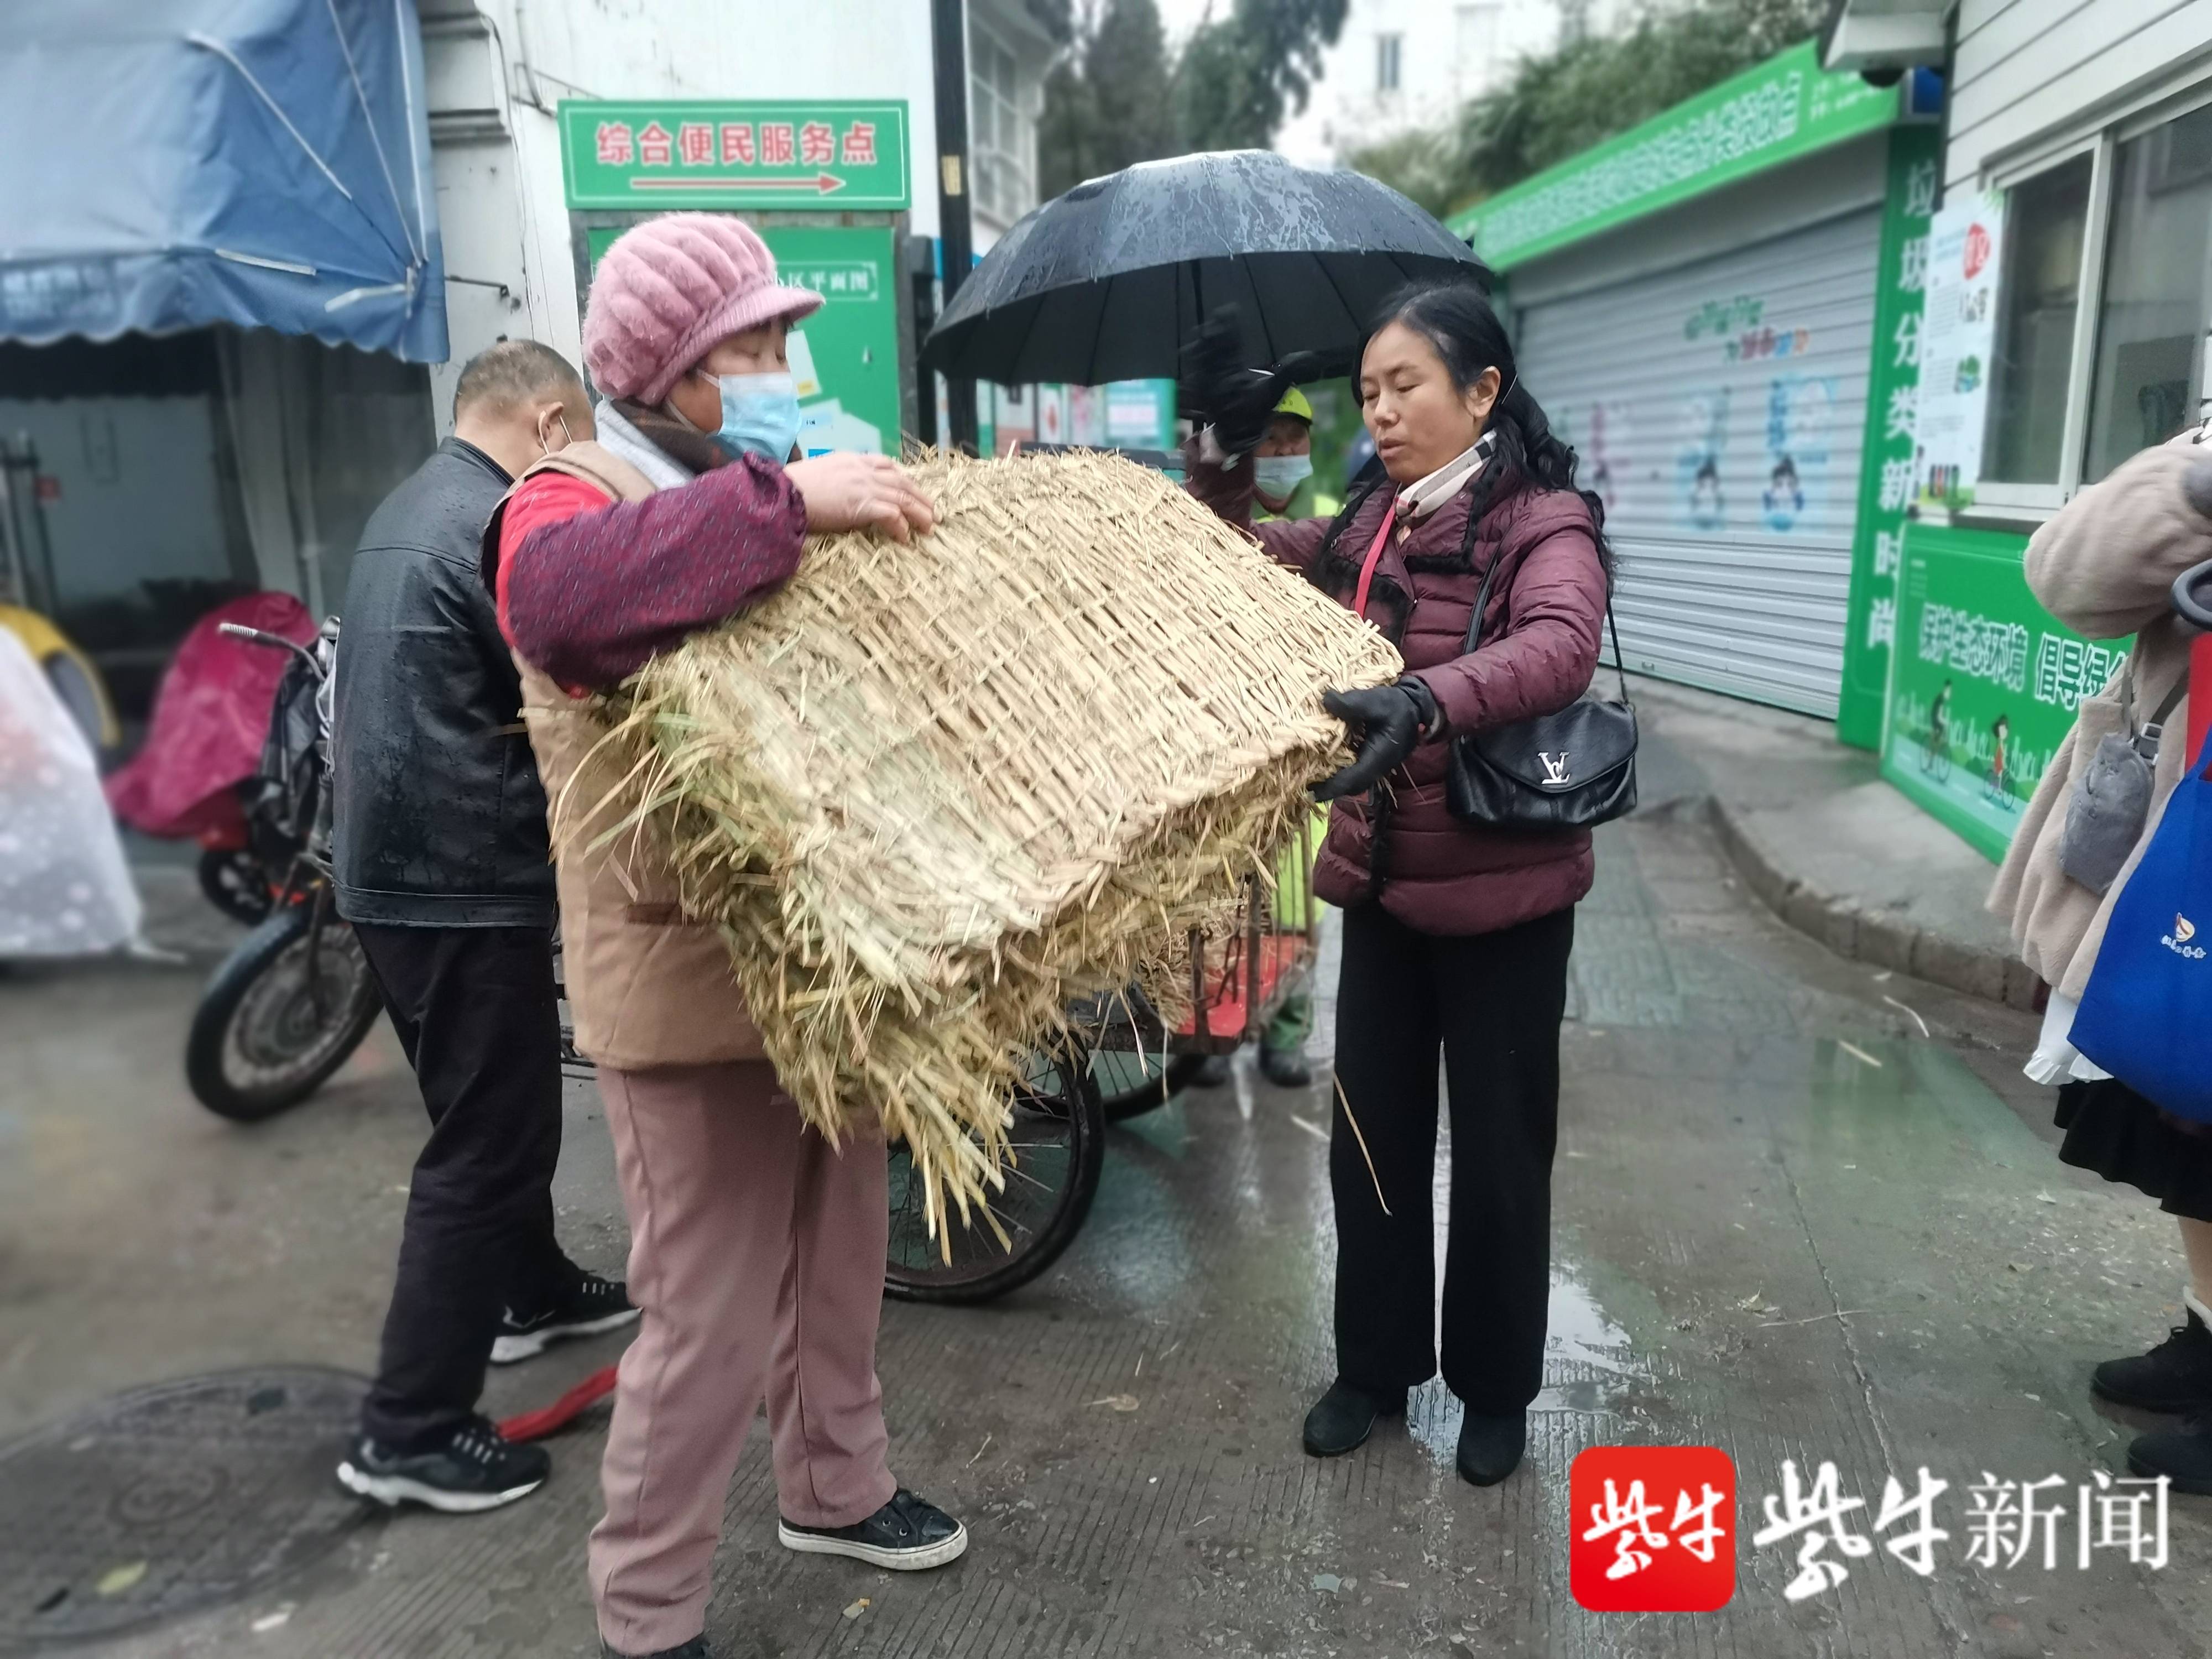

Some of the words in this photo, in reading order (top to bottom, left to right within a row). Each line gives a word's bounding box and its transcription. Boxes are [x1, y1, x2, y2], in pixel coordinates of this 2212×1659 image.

[595, 121, 878, 166] 综合便民服务点
